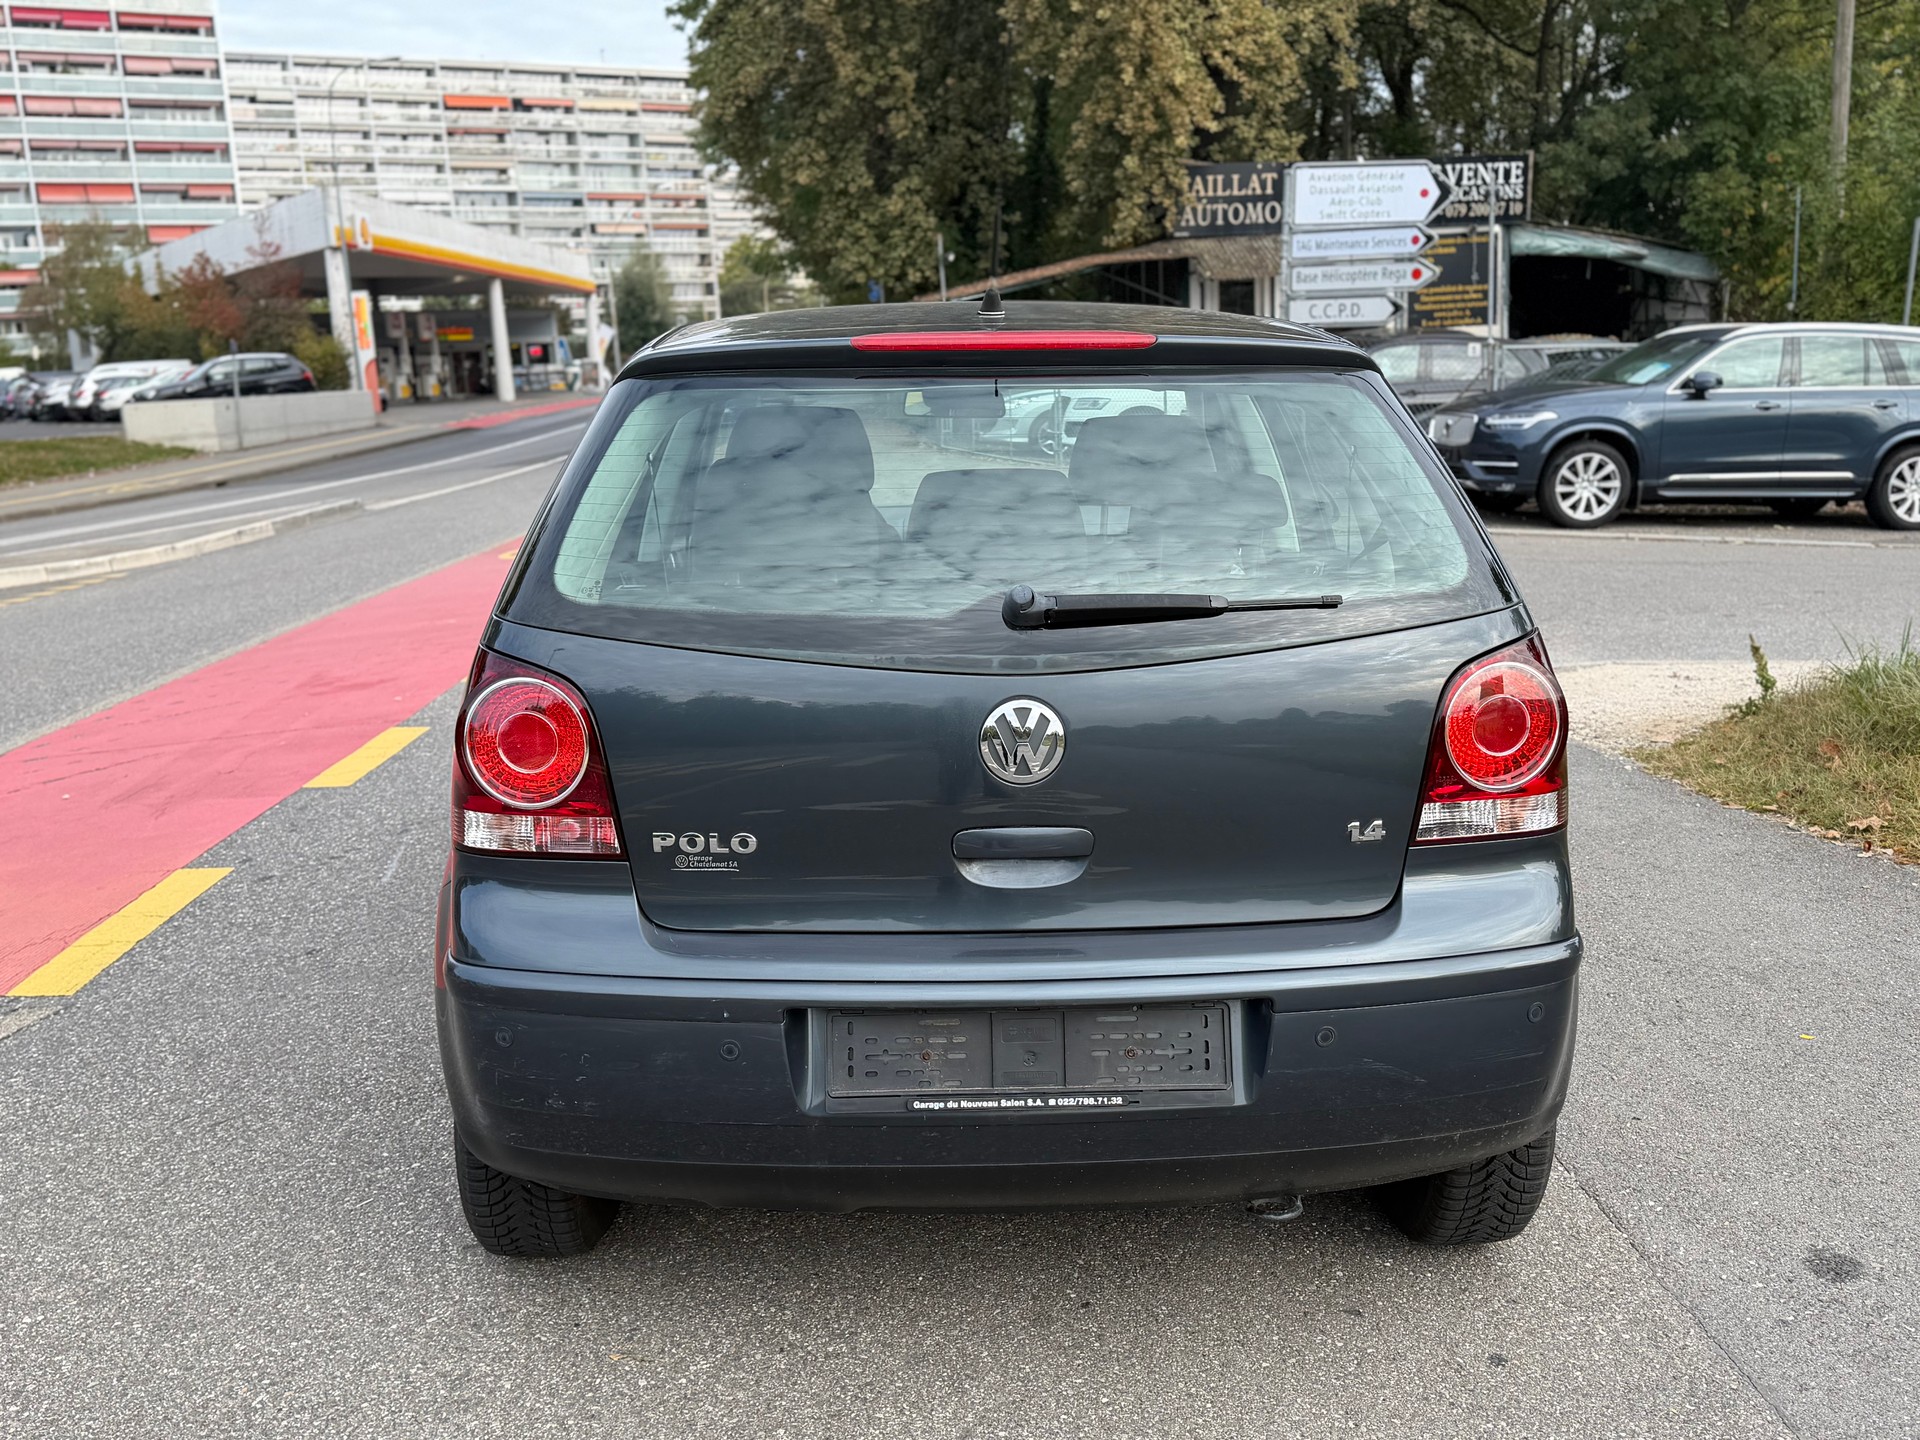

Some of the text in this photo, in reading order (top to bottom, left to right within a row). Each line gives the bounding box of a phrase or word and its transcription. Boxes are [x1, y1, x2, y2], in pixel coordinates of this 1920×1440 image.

[1308, 169, 1405, 183] Aviation Générale
[1445, 161, 1525, 185] VENTE
[1187, 172, 1279, 197] AILLAT
[1309, 183, 1404, 195] Dassault Aviation
[1329, 196, 1384, 207] Aéro-Club
[1508, 200, 1524, 216] 10
[1180, 201, 1282, 227] AUTOMO
[1319, 208, 1391, 220] Swift Copters
[1315, 237, 1369, 251] Maintenance
[1371, 235, 1407, 249] Services
[1296, 266, 1407, 285] Base Hélicoptère Rega
[1308, 302, 1365, 319] C.C.P.D.
[652, 832, 758, 854] POLO
[688, 854, 713, 862] Garage
[728, 860, 738, 868] SA
[913, 1096, 1123, 1110] Garage du Nouveau Salon S.A. 022/798.71.32
